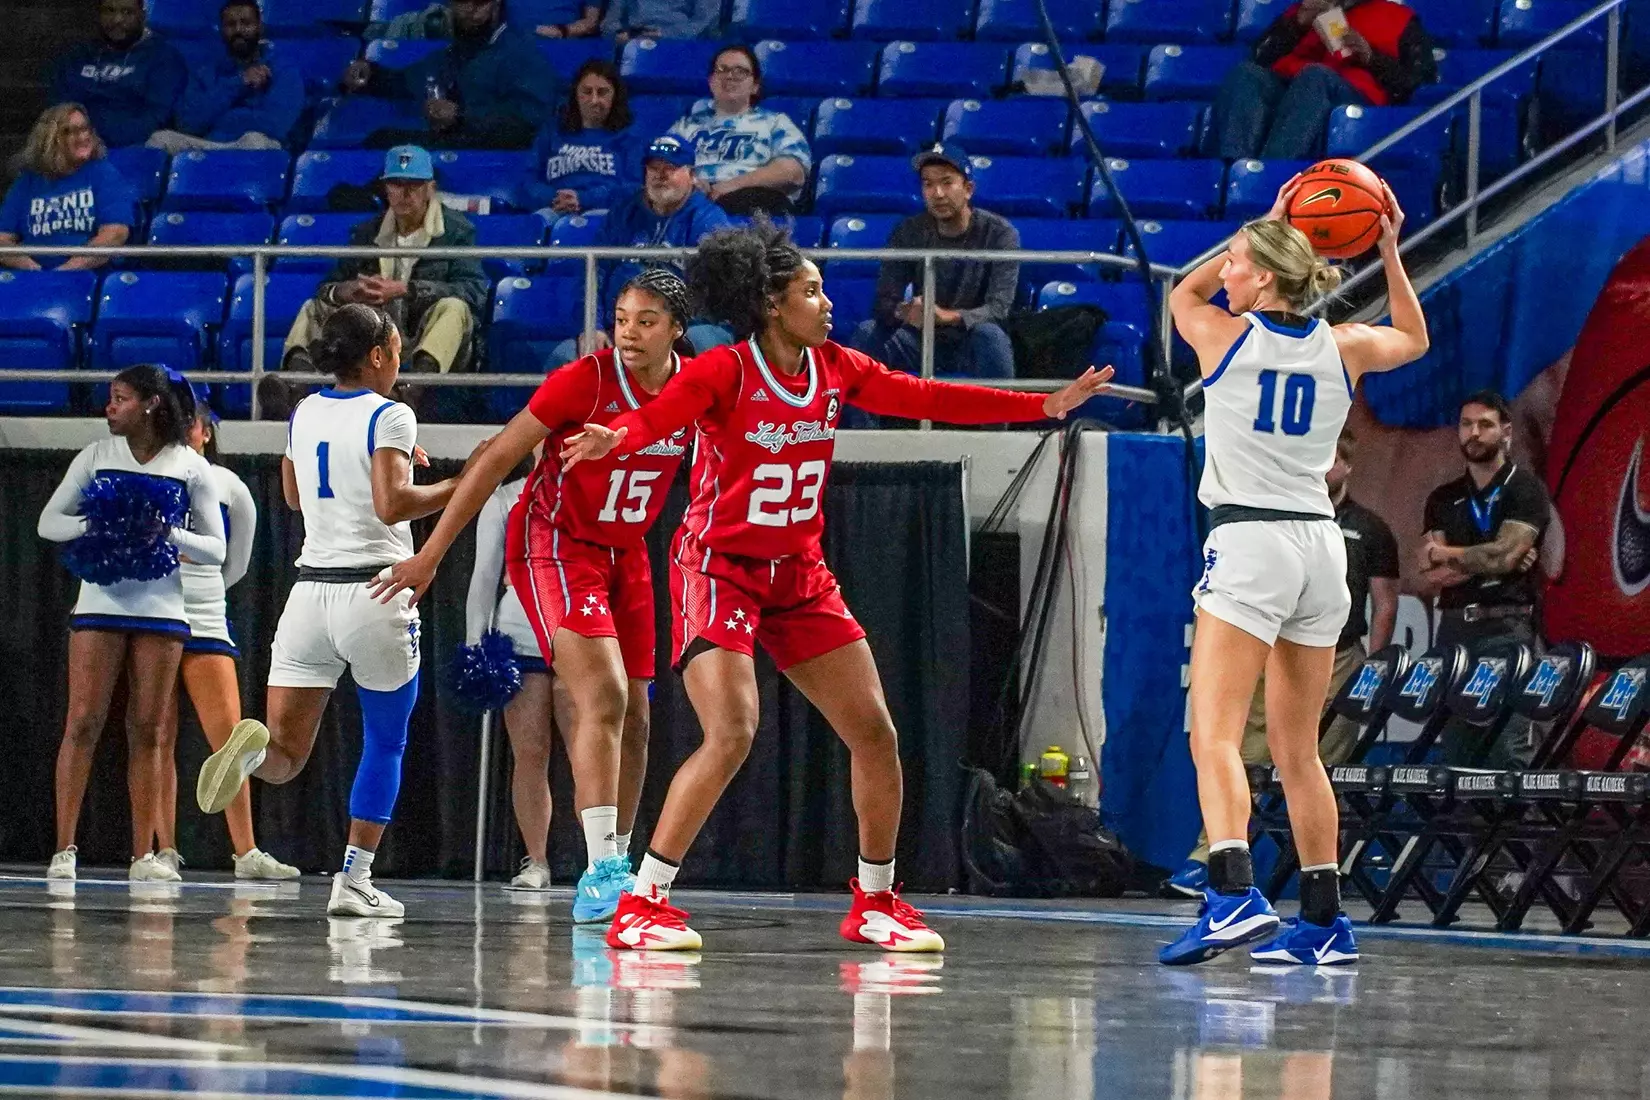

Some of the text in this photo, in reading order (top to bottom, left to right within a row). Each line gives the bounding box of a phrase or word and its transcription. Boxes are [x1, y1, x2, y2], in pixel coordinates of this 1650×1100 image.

[31, 190, 94, 215] BAND
[1253, 368, 1316, 436] 10
[745, 421, 787, 455] Lady
[316, 441, 335, 499] 1
[747, 460, 825, 526] 23
[598, 469, 662, 522] 15
[1347, 664, 1382, 712] MT
[1400, 661, 1437, 708] MT
[1461, 661, 1500, 708] MT
[1523, 660, 1564, 707] MT
[1599, 672, 1640, 720] MT
